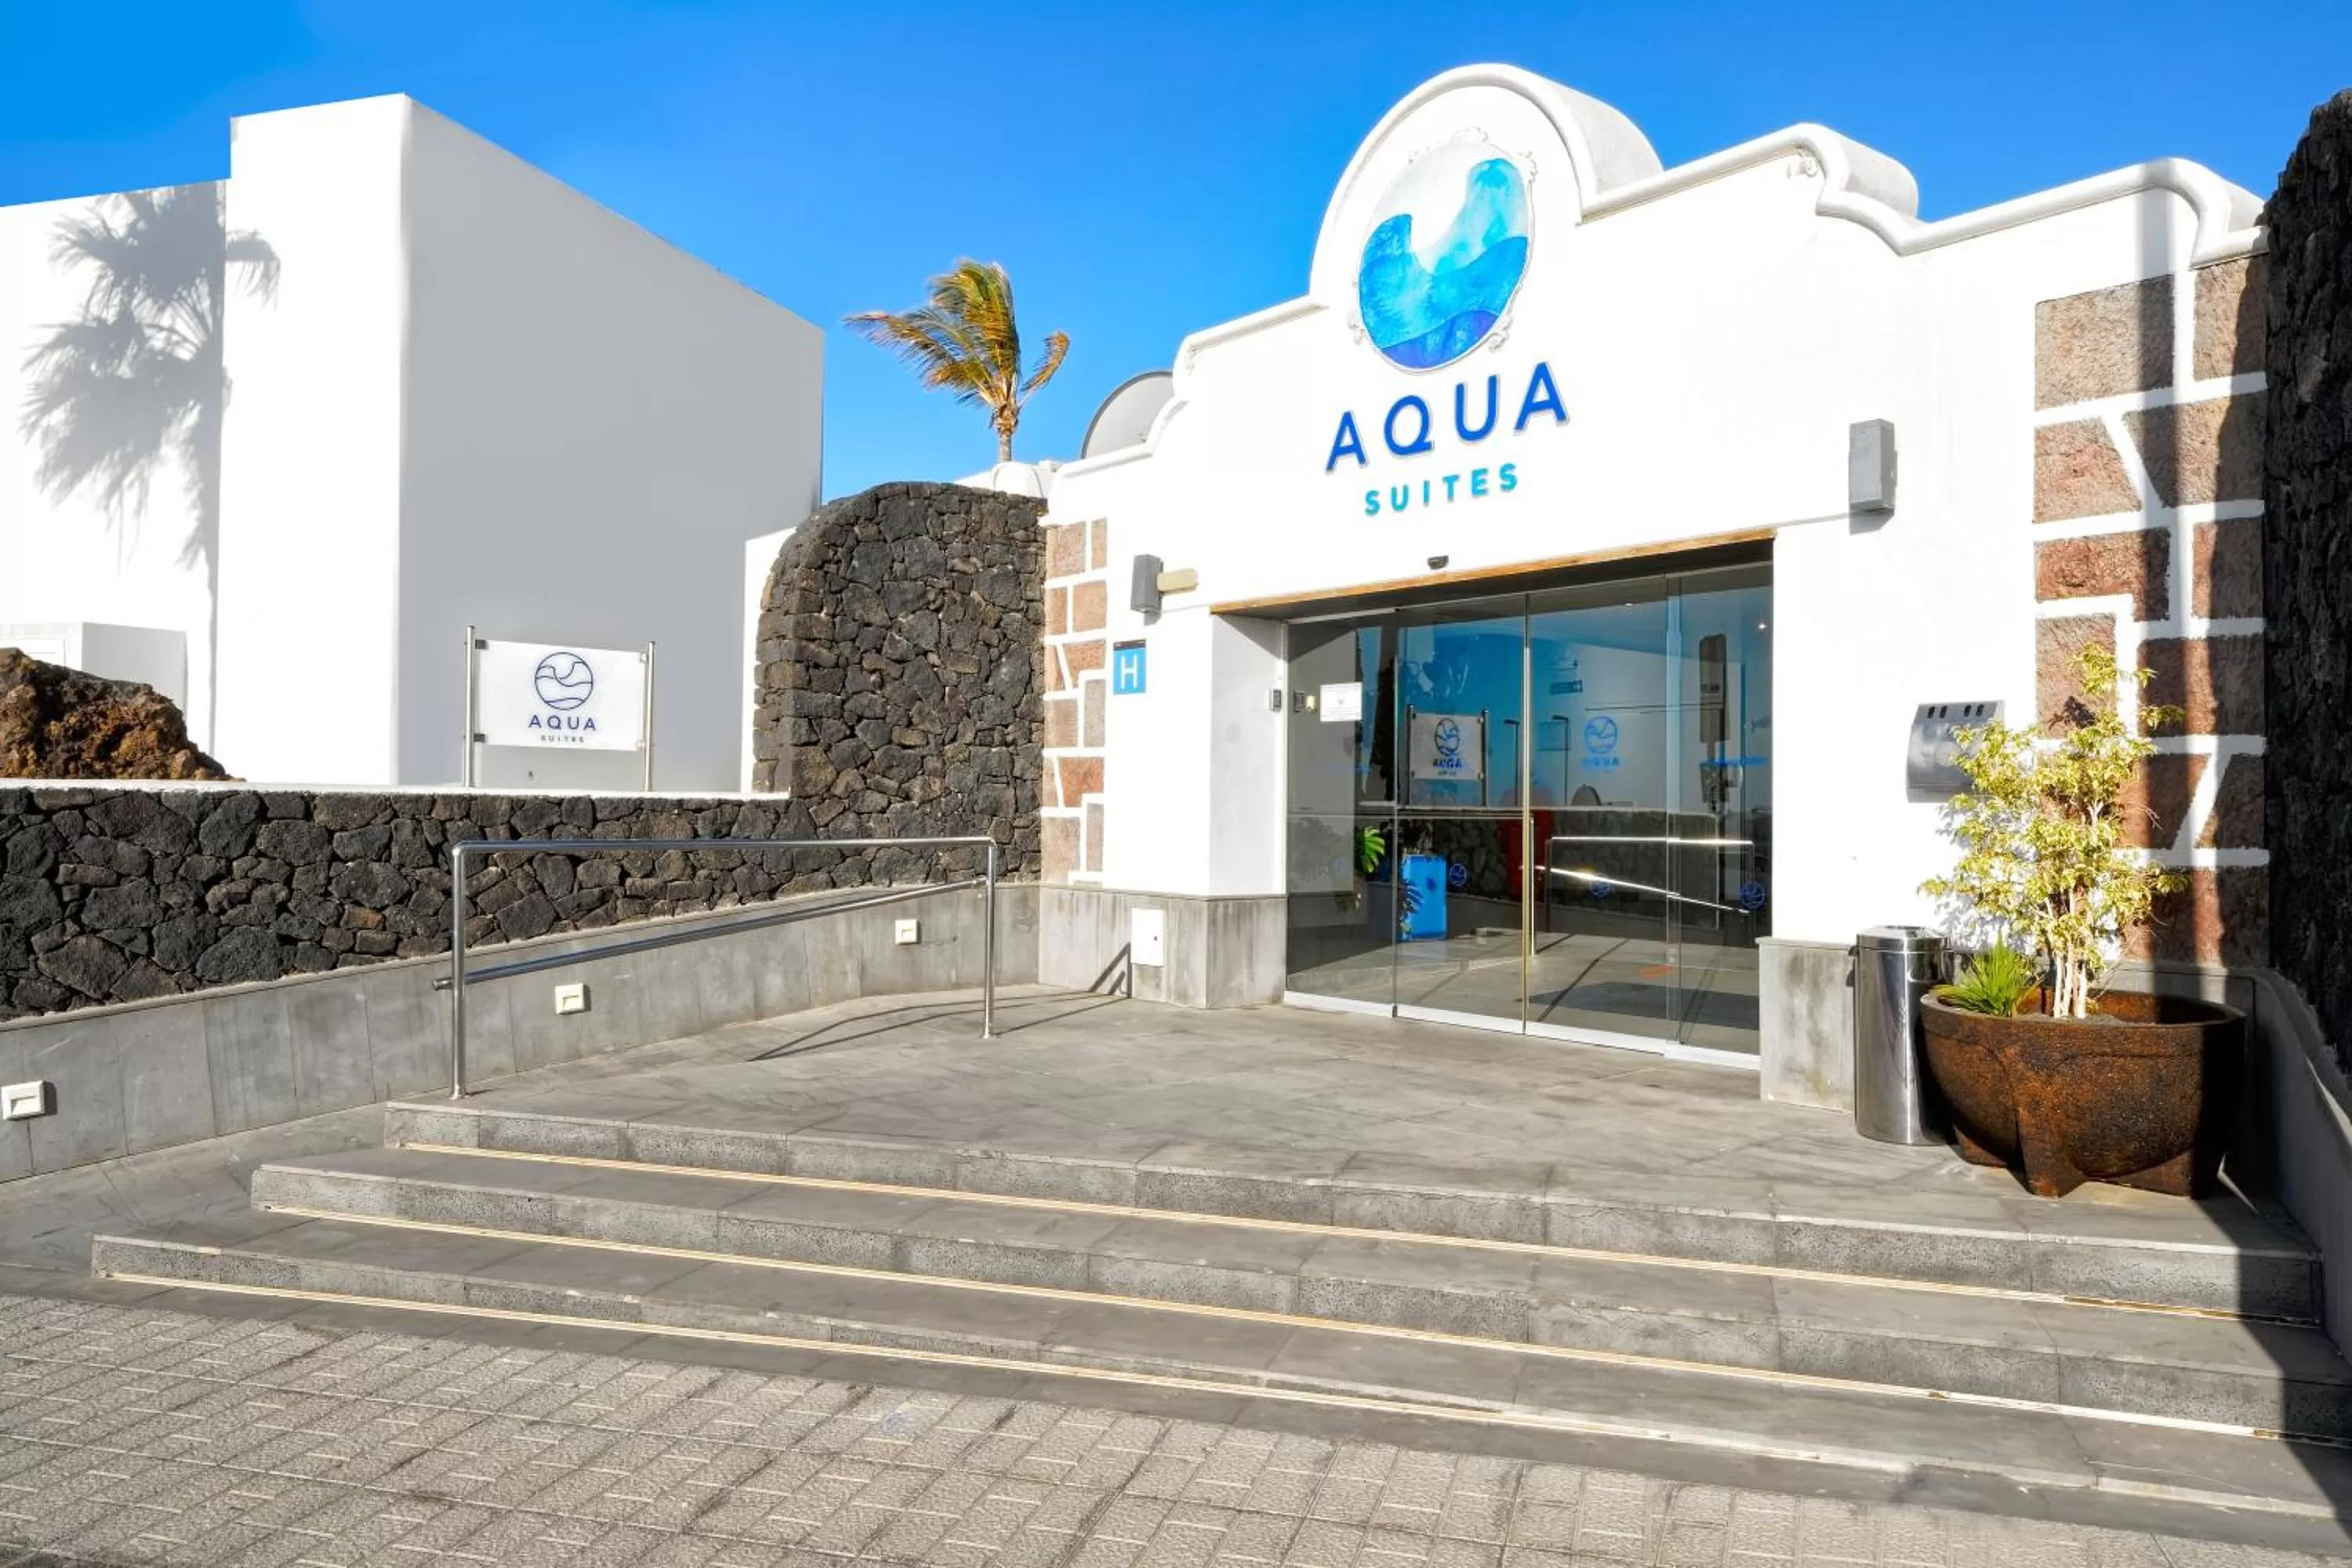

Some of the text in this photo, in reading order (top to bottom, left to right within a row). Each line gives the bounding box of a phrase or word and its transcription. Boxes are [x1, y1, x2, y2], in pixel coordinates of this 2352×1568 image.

[1326, 361, 1568, 473] AQUA
[1364, 463, 1518, 516] SUITES
[1120, 653, 1138, 690] H
[528, 714, 596, 731] AQUA
